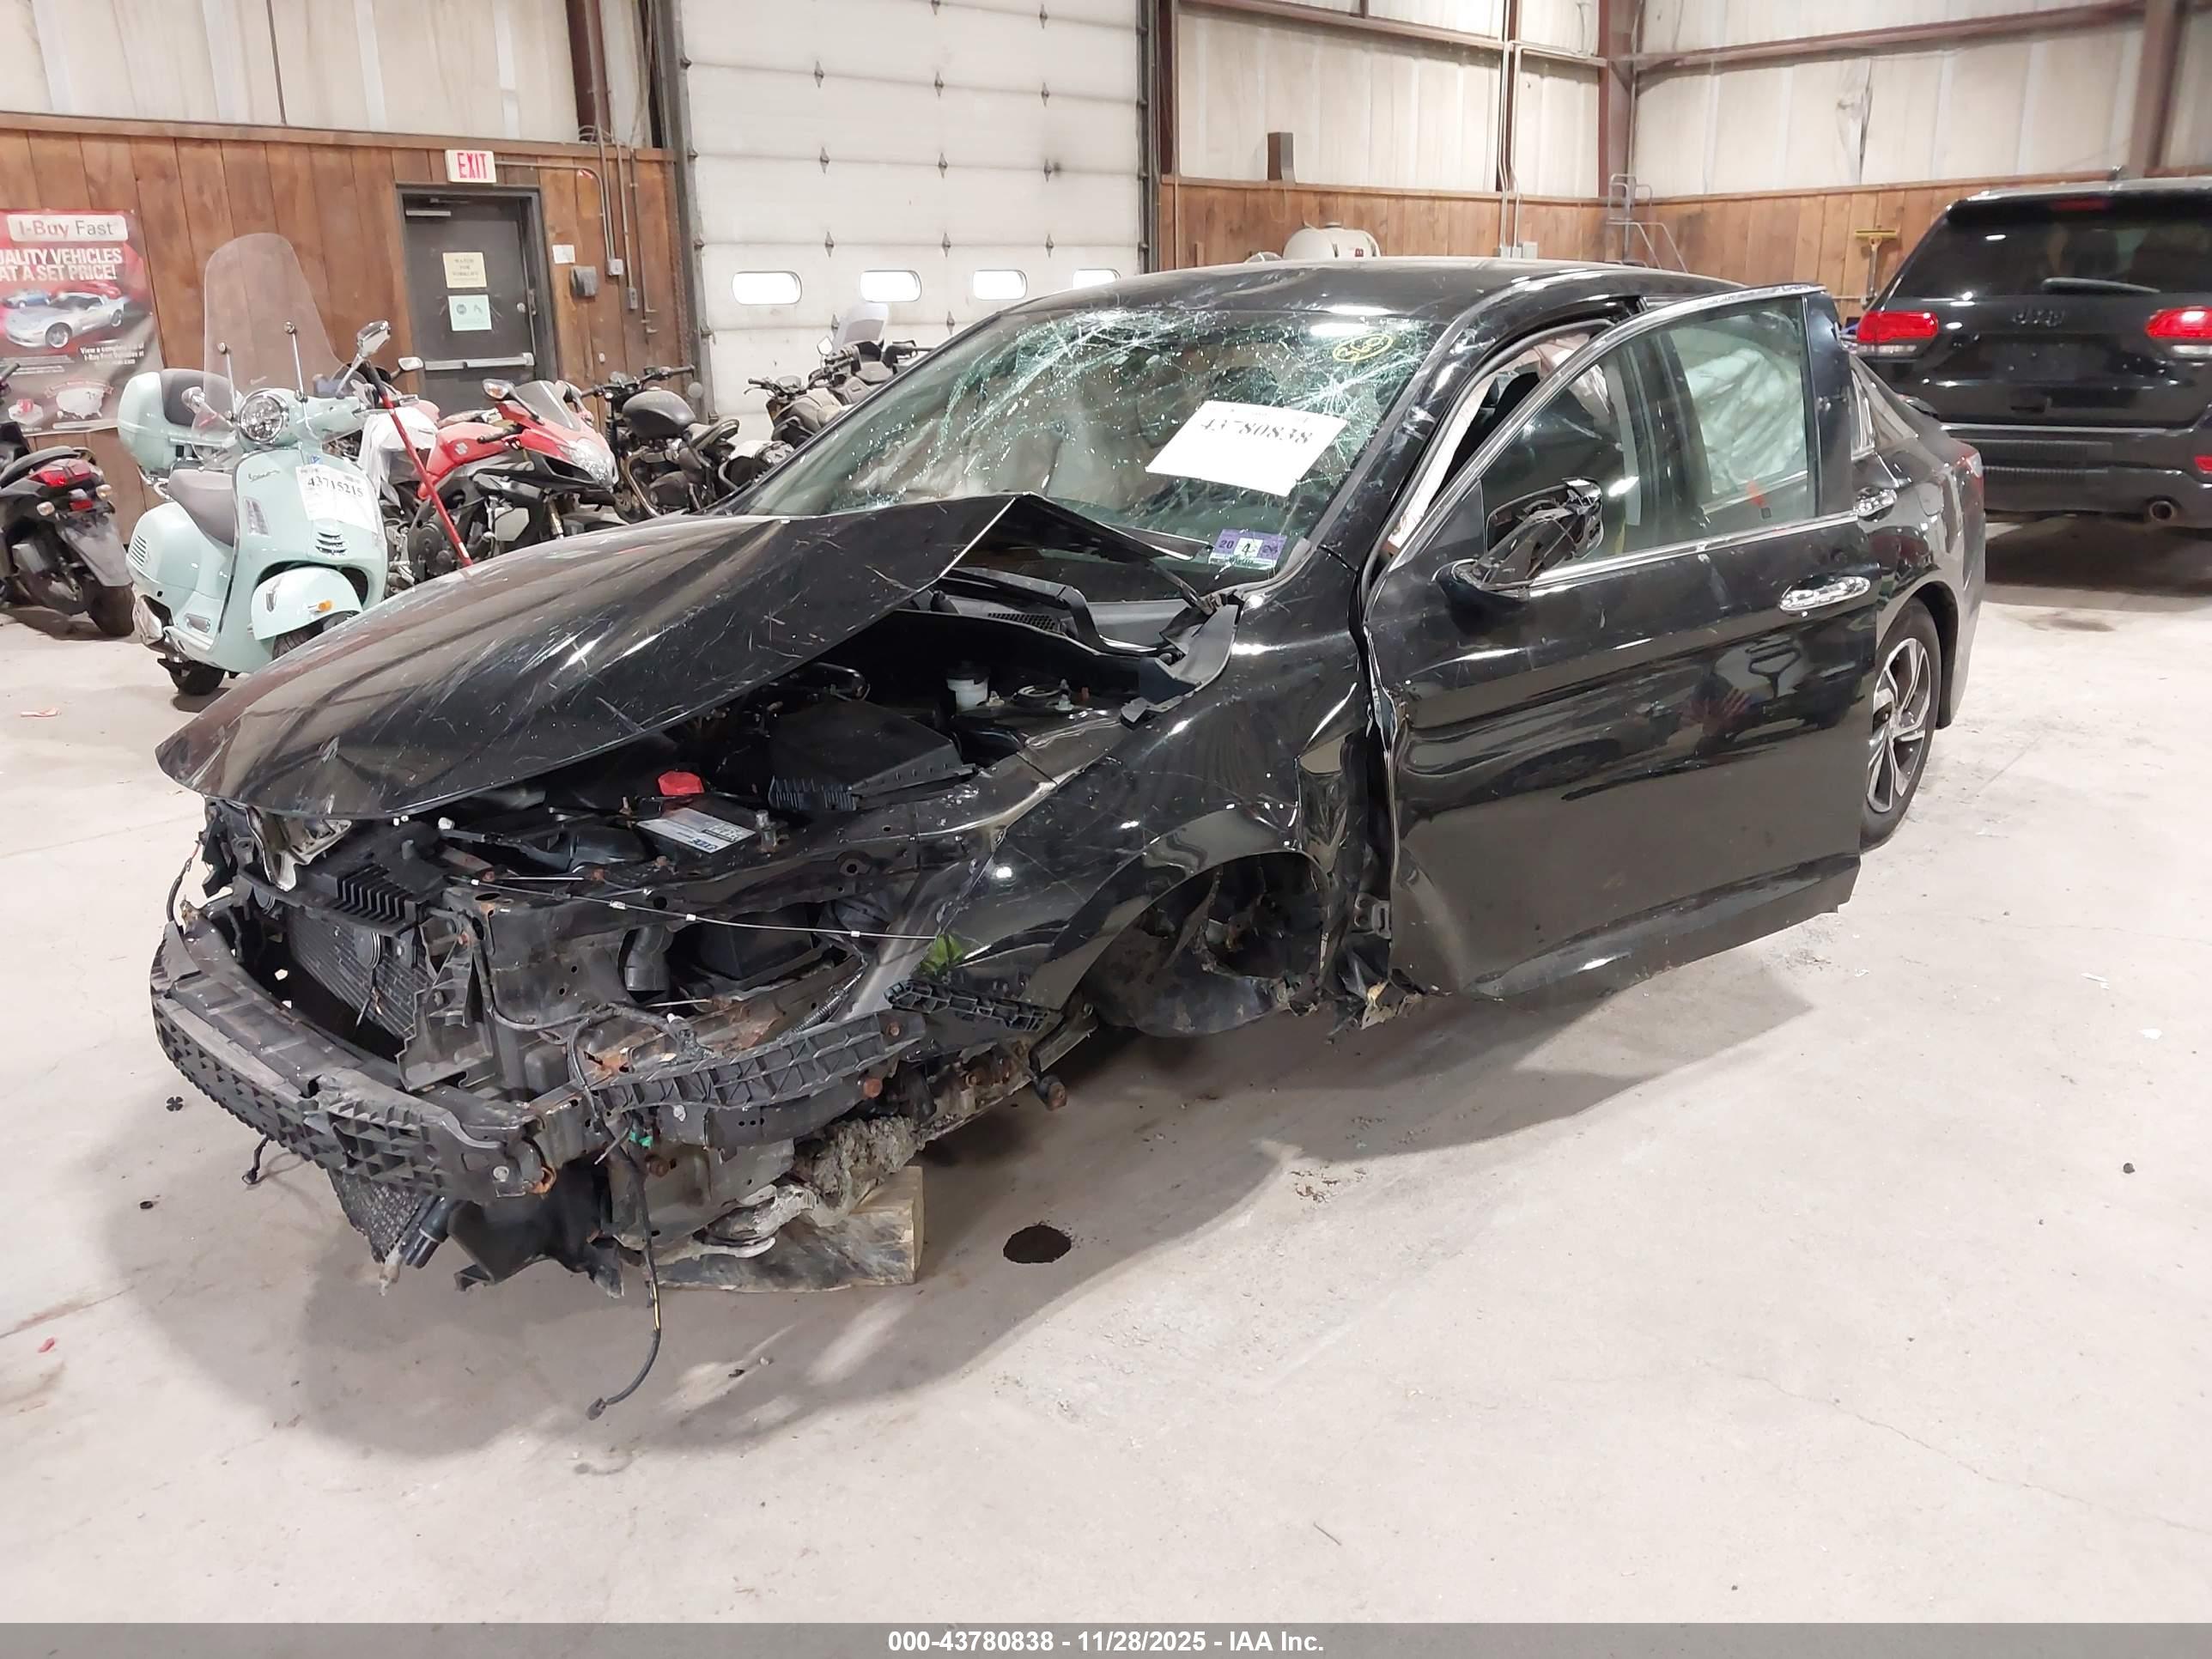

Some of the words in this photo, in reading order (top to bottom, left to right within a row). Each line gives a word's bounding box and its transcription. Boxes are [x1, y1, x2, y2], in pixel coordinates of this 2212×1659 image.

[457, 152, 487, 179] EXIT
[18, 220, 69, 238] I-Buy
[75, 220, 114, 235] Fast
[50, 248, 123, 264] VEHICLES
[0, 265, 17, 282] AT
[23, 265, 36, 282] A
[36, 264, 65, 282] SET
[69, 264, 117, 281] PRICE!
[307, 475, 364, 497] 43715215
[1218, 540, 1235, 550] 20
[1242, 543, 1251, 556] 4
